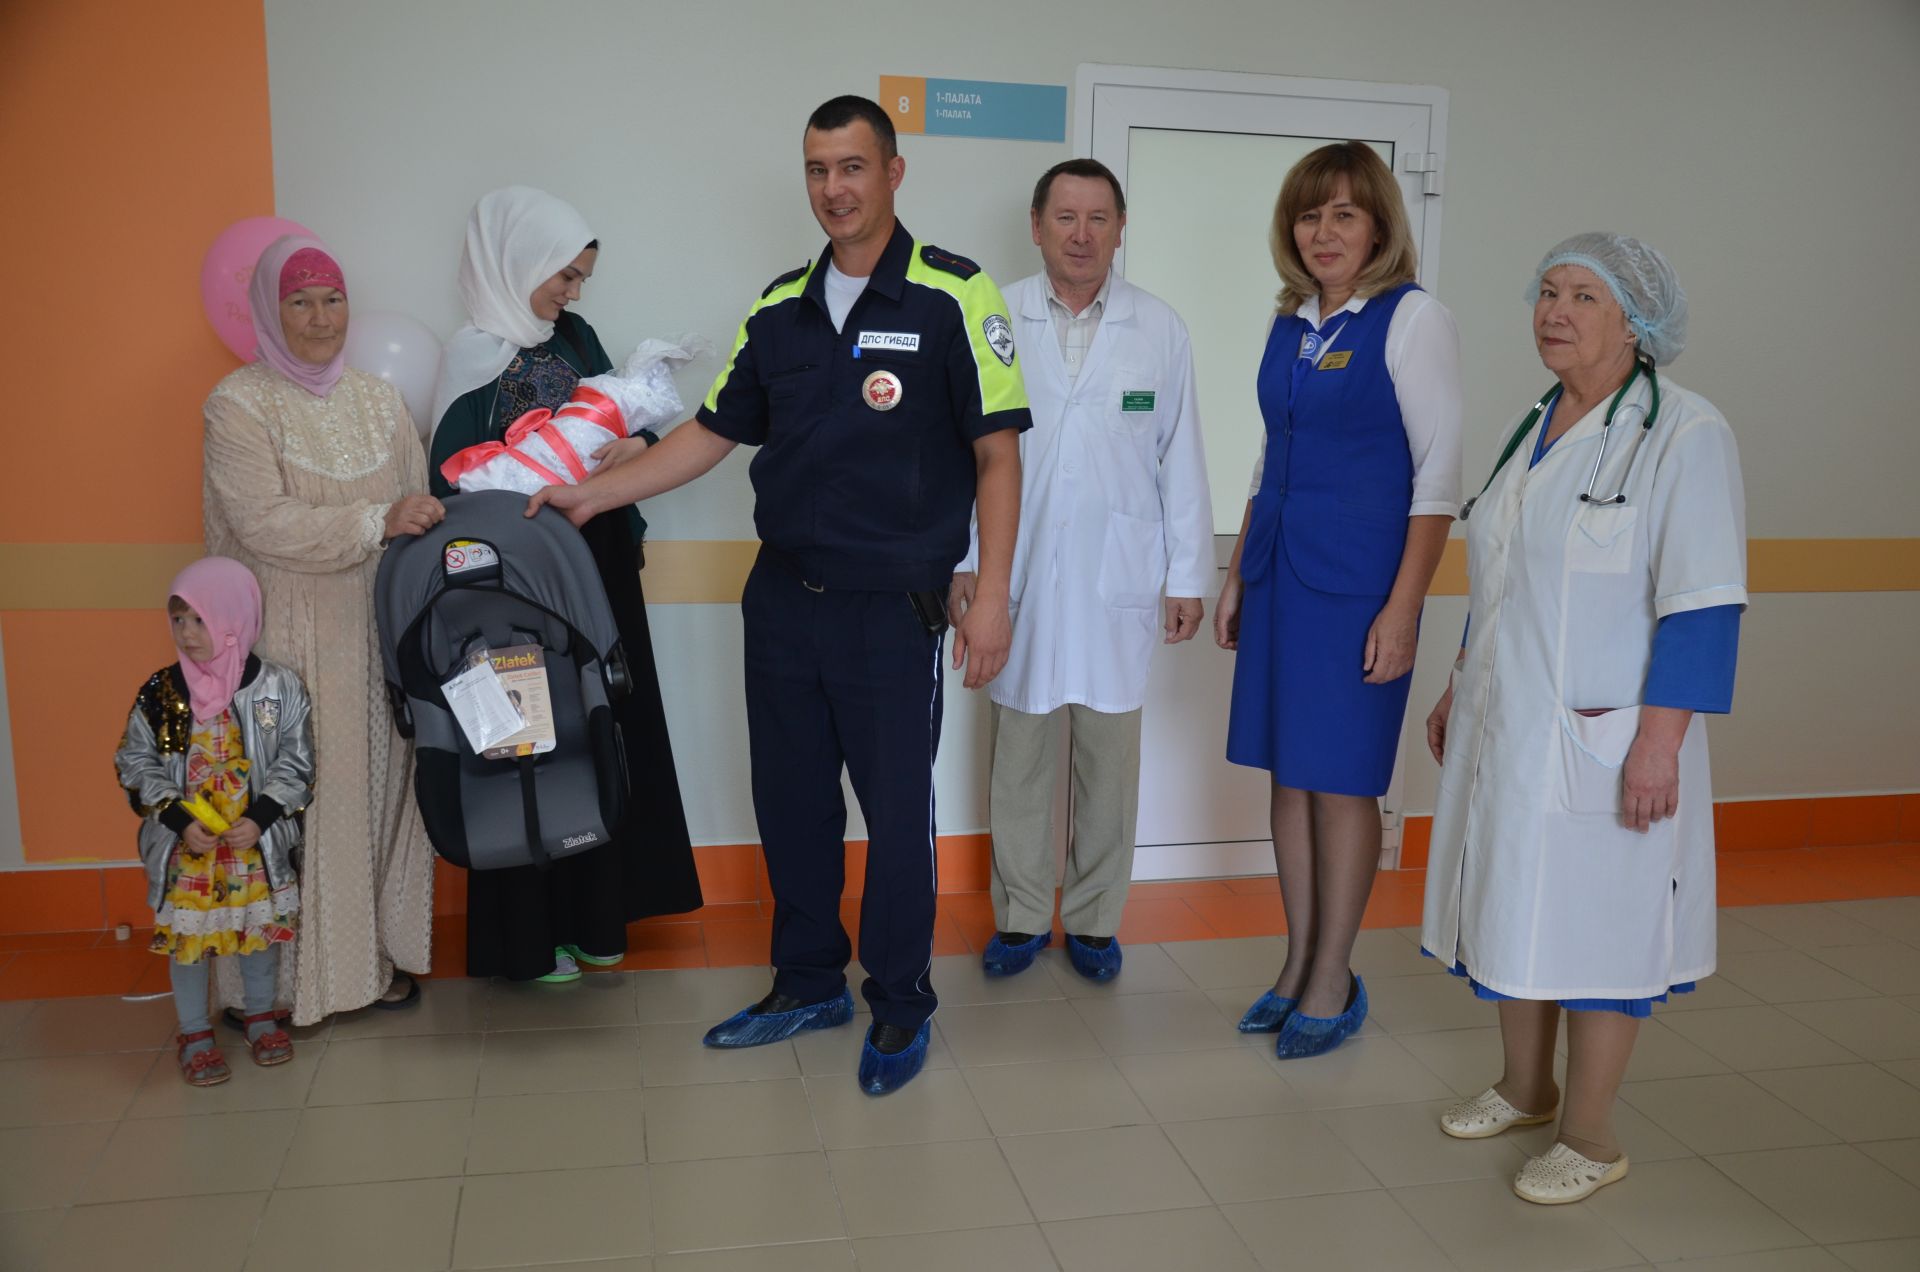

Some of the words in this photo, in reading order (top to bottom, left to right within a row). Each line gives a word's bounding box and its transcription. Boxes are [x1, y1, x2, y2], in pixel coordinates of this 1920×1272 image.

[898, 96, 910, 113] 8
[936, 91, 982, 105] 1-ПАЛАТА
[935, 108, 972, 119] 1-ПАЛАТА
[860, 334, 882, 345] ДПС
[883, 335, 917, 348] ГИБДД
[494, 653, 536, 670] Zlatek
[562, 832, 598, 849] Zlatek
